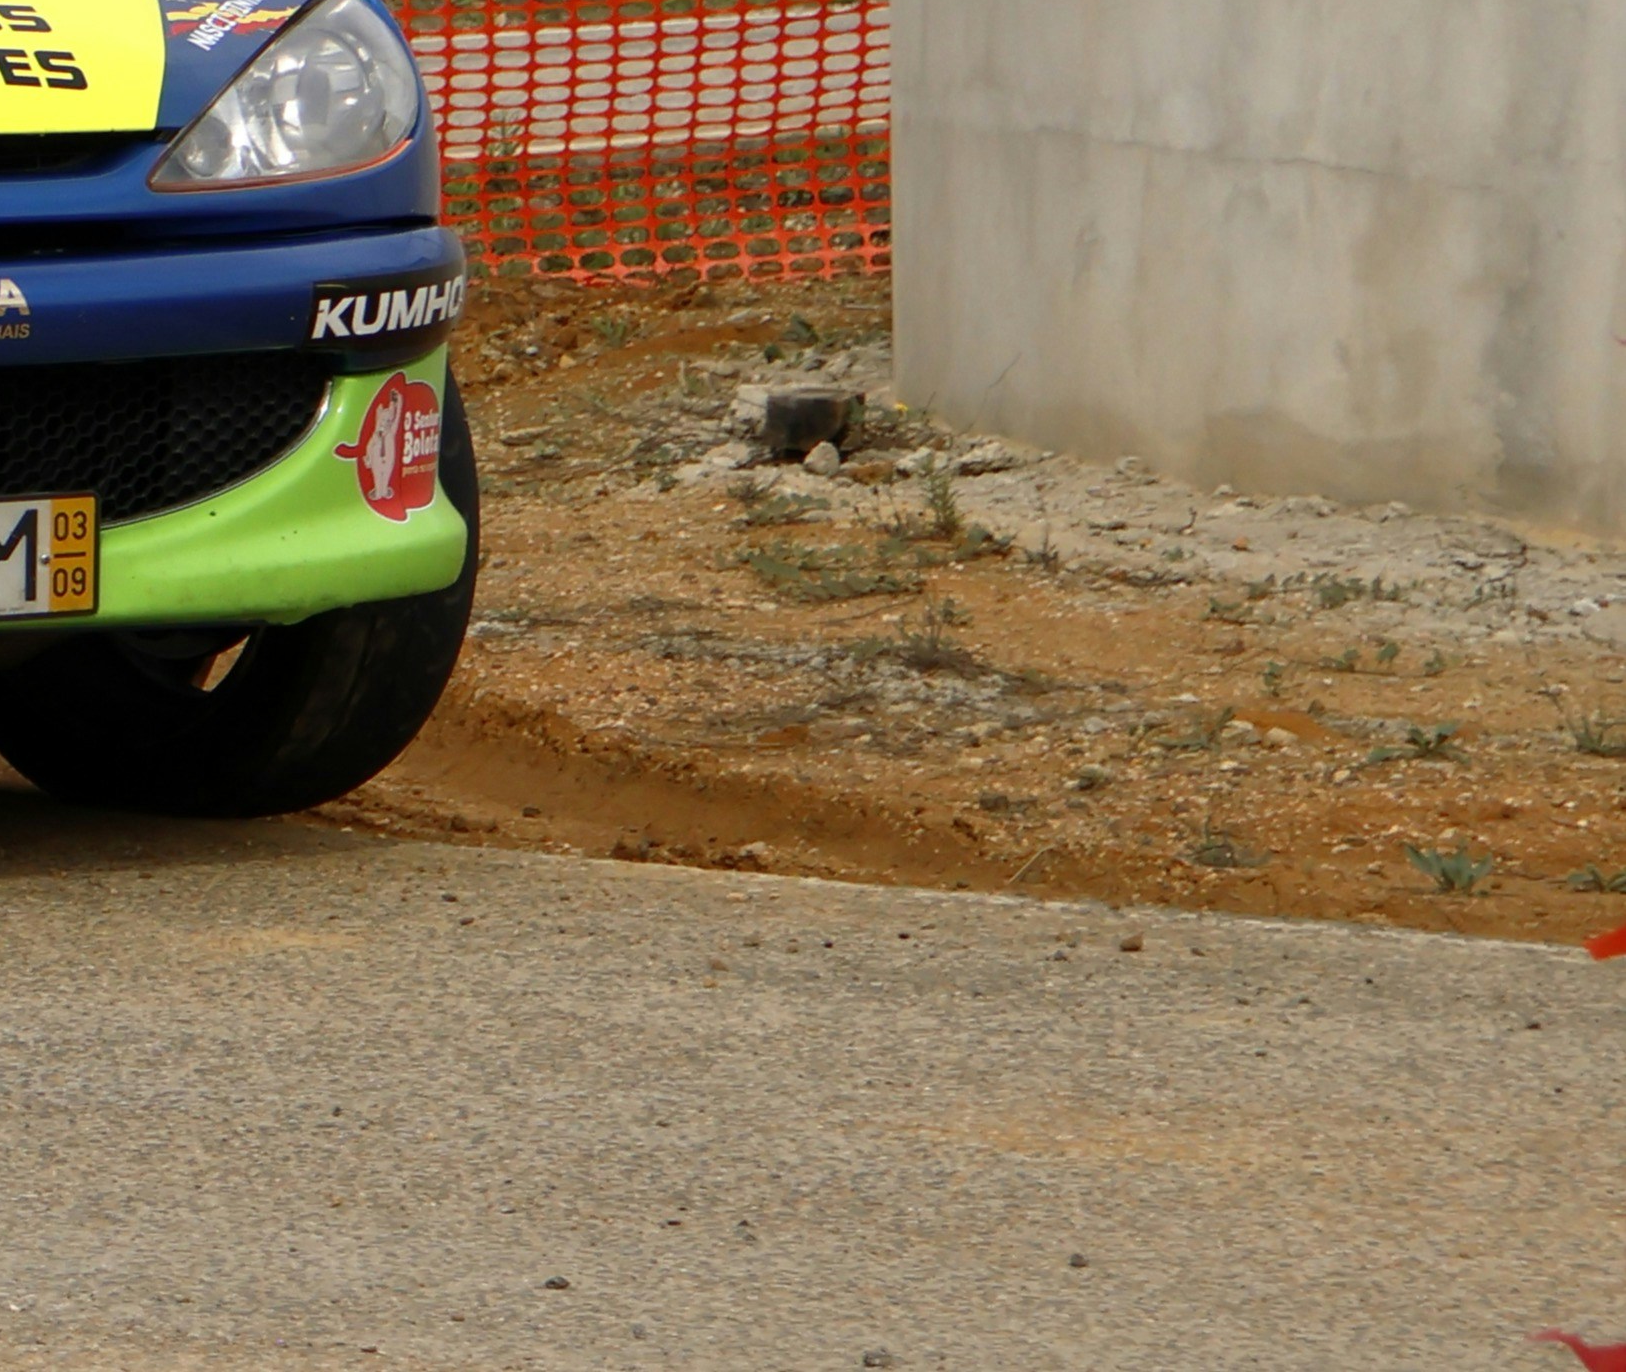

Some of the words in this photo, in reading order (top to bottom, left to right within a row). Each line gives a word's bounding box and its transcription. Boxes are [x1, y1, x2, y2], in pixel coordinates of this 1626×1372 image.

[186, 12, 237, 52] NASCI
[311, 275, 464, 340] KUMHO
[54, 510, 87, 541] 03
[53, 566, 86, 597] 09
